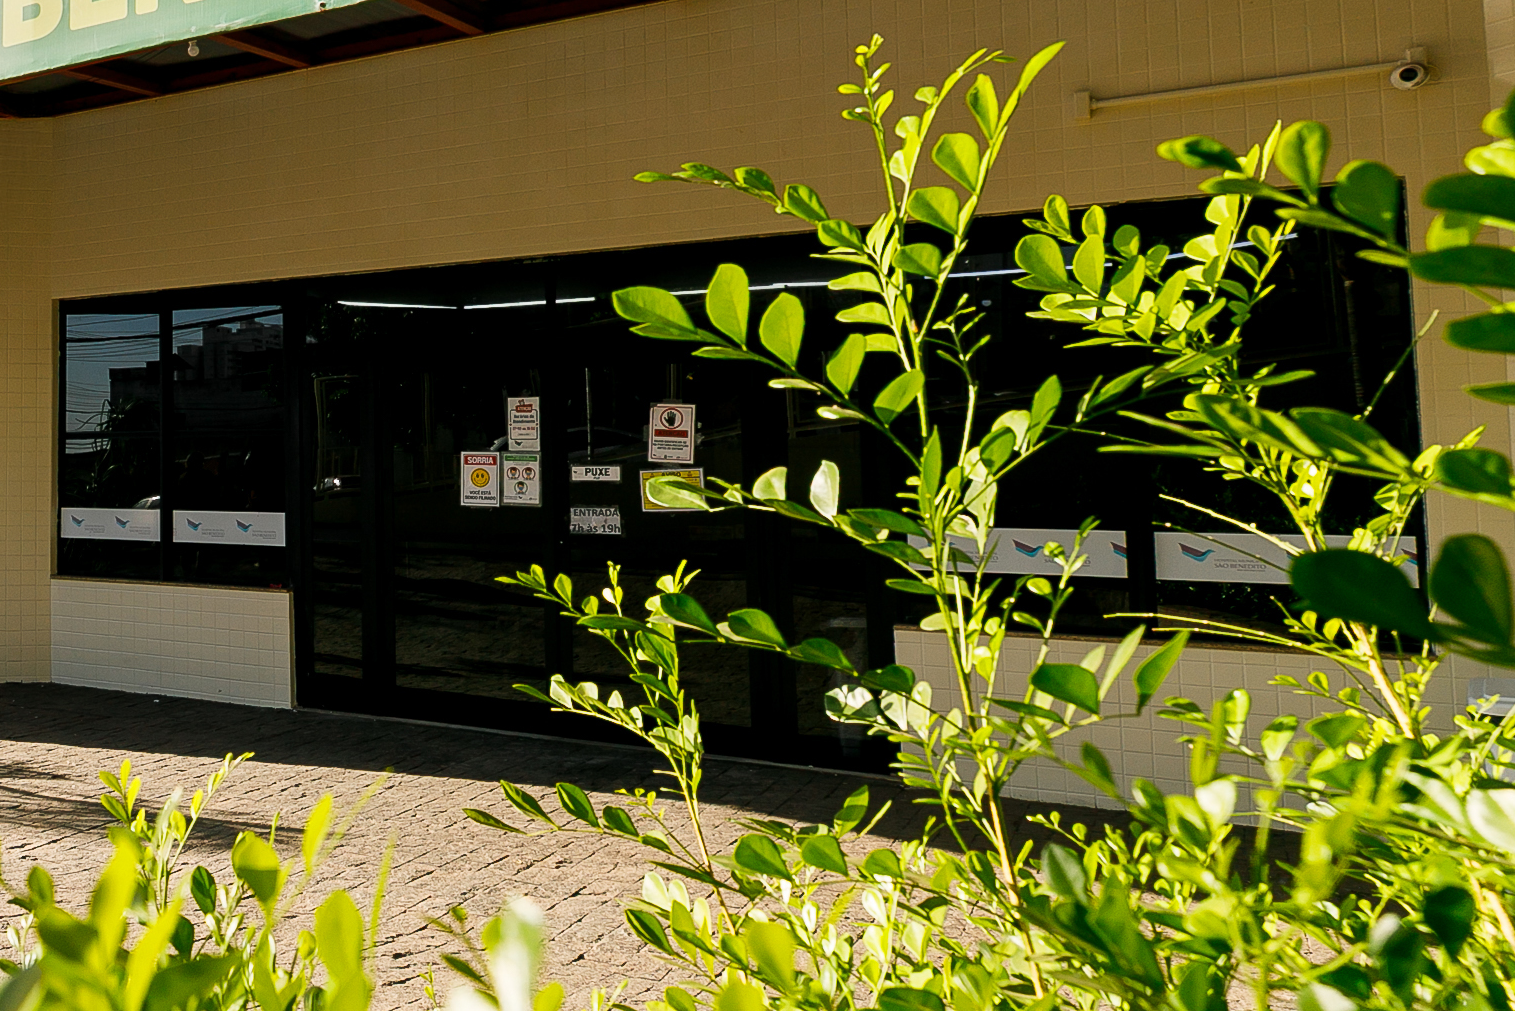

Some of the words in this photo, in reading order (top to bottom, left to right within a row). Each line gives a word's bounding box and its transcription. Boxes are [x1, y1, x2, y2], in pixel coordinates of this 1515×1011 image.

[467, 456, 494, 464] SORRIA
[584, 467, 611, 476] PUXE
[573, 508, 620, 517] ENTRADA
[571, 523, 585, 533] 7h
[586, 523, 599, 533] às
[601, 523, 621, 533] 19h
